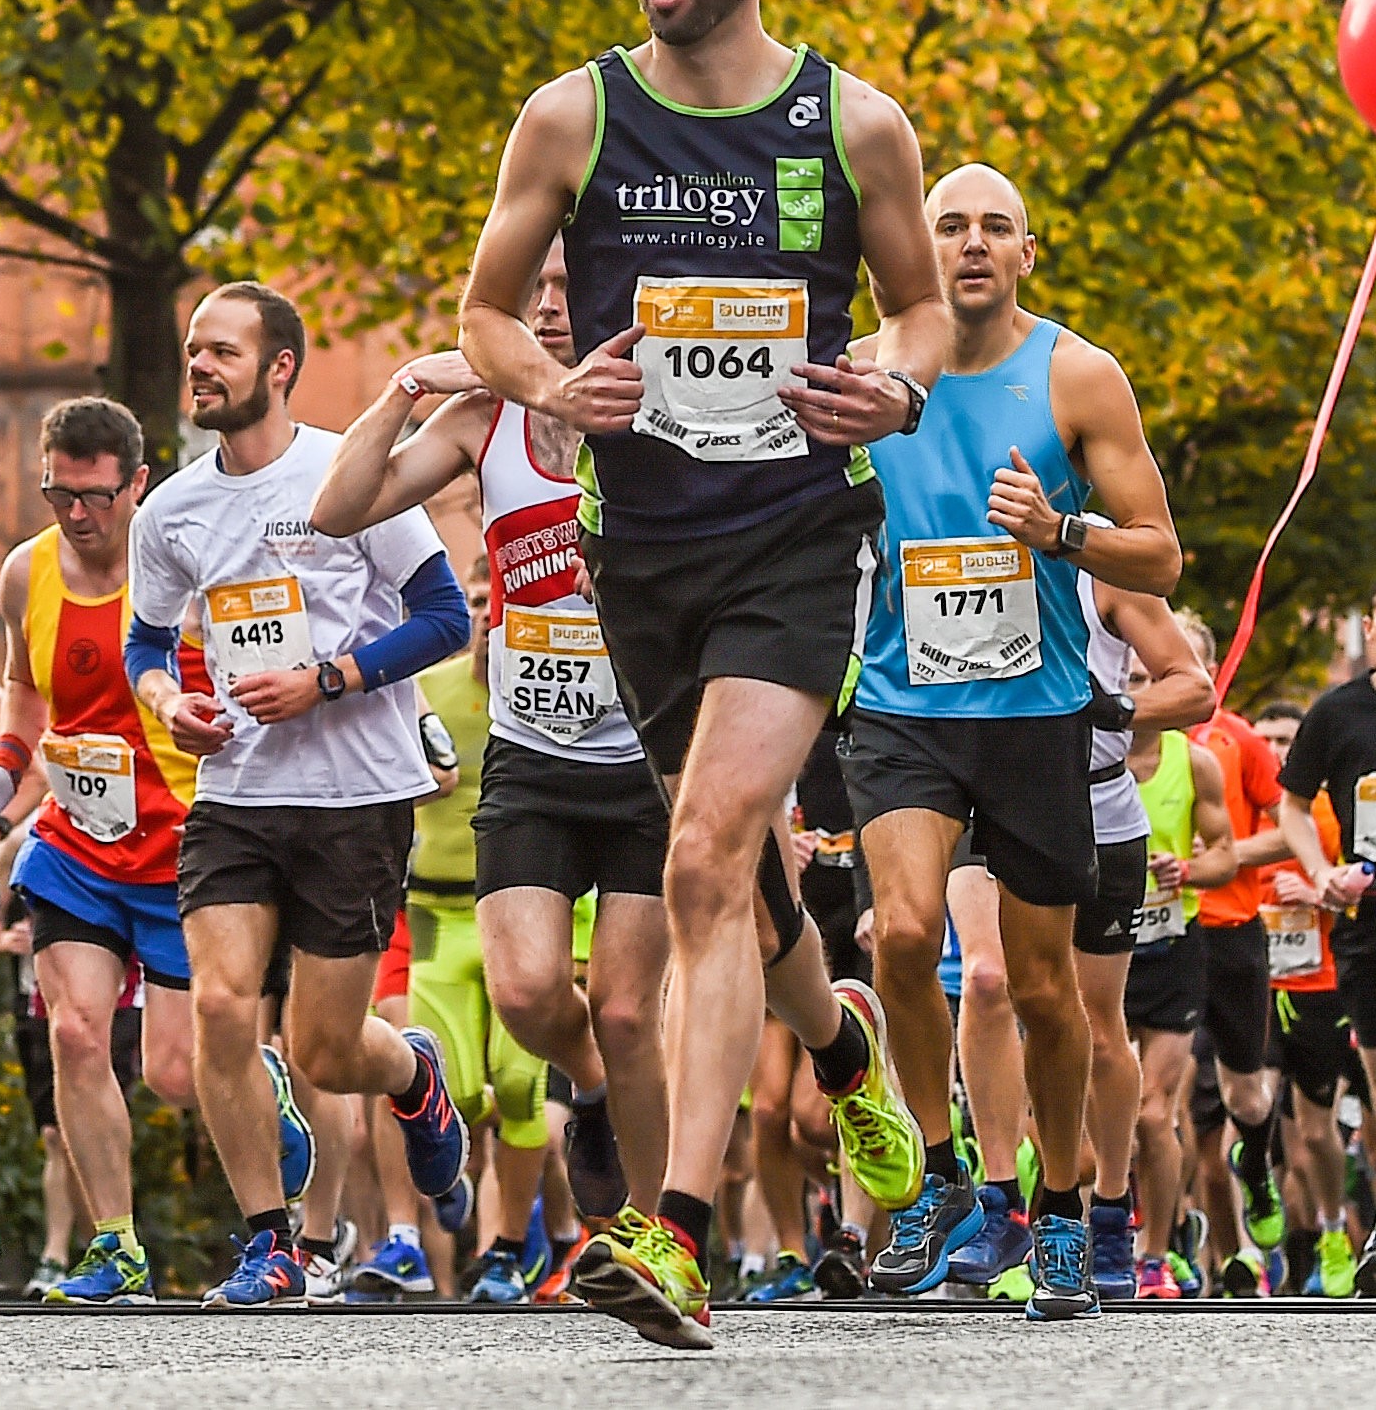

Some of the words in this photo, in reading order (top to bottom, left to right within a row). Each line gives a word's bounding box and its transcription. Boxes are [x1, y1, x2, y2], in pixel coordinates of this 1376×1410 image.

[682, 171, 755, 186] triathlon
[616, 174, 766, 226] trilogy
[621, 231, 765, 249] www.trilogy.ie
[719, 303, 784, 317] DUBLIN
[664, 345, 774, 379] 1064
[711, 434, 743, 446] asics
[768, 429, 798, 452] 1064
[503, 546, 578, 595] RUNNING
[966, 555, 1015, 568] DUBLIN
[933, 588, 1004, 617] 1771
[231, 620, 284, 648] 4413
[553, 628, 599, 640] DUBLIN
[519, 656, 591, 685] 2657
[916, 662, 936, 679] 1771
[513, 684, 595, 717] SEÁN
[65, 771, 107, 798] 709
